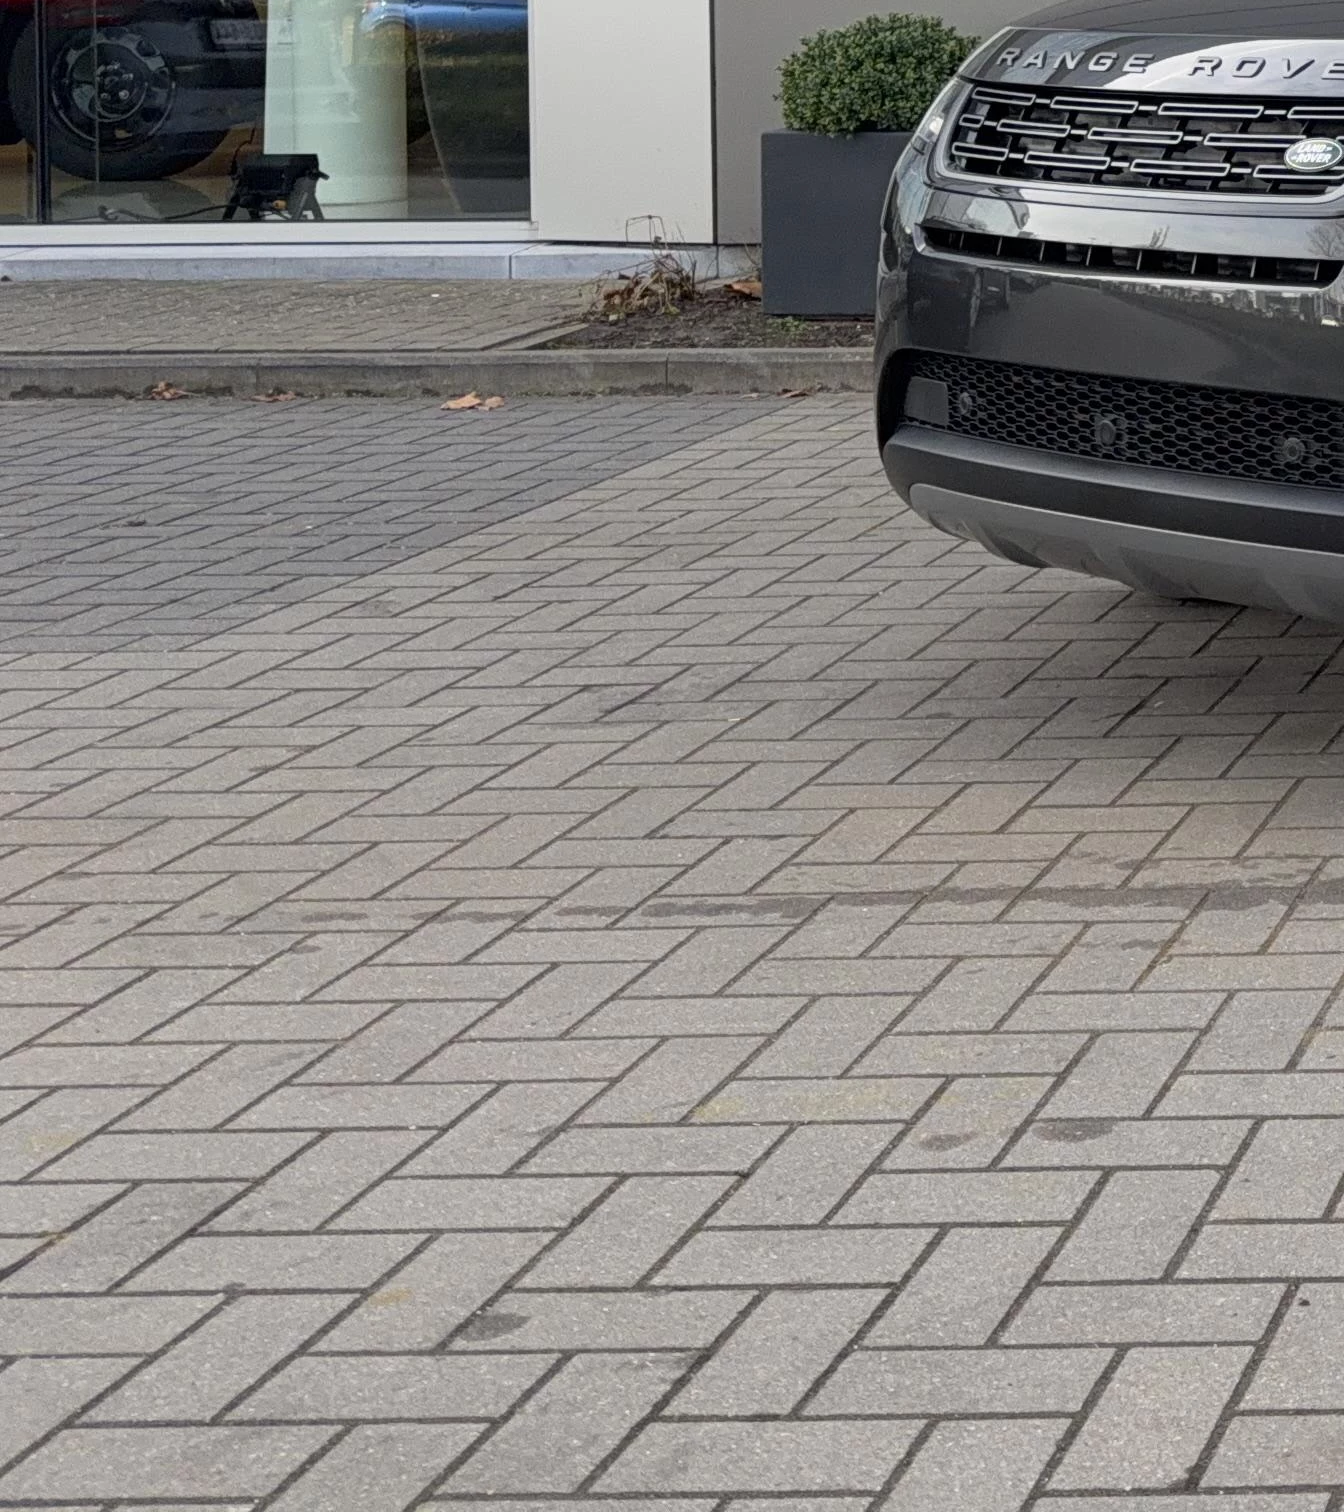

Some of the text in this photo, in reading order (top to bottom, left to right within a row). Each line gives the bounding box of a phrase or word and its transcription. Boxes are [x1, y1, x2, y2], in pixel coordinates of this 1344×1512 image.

[996, 47, 1155, 75] RANGE
[1296, 143, 1327, 153] LAND
[1295, 153, 1332, 164] ROVER
